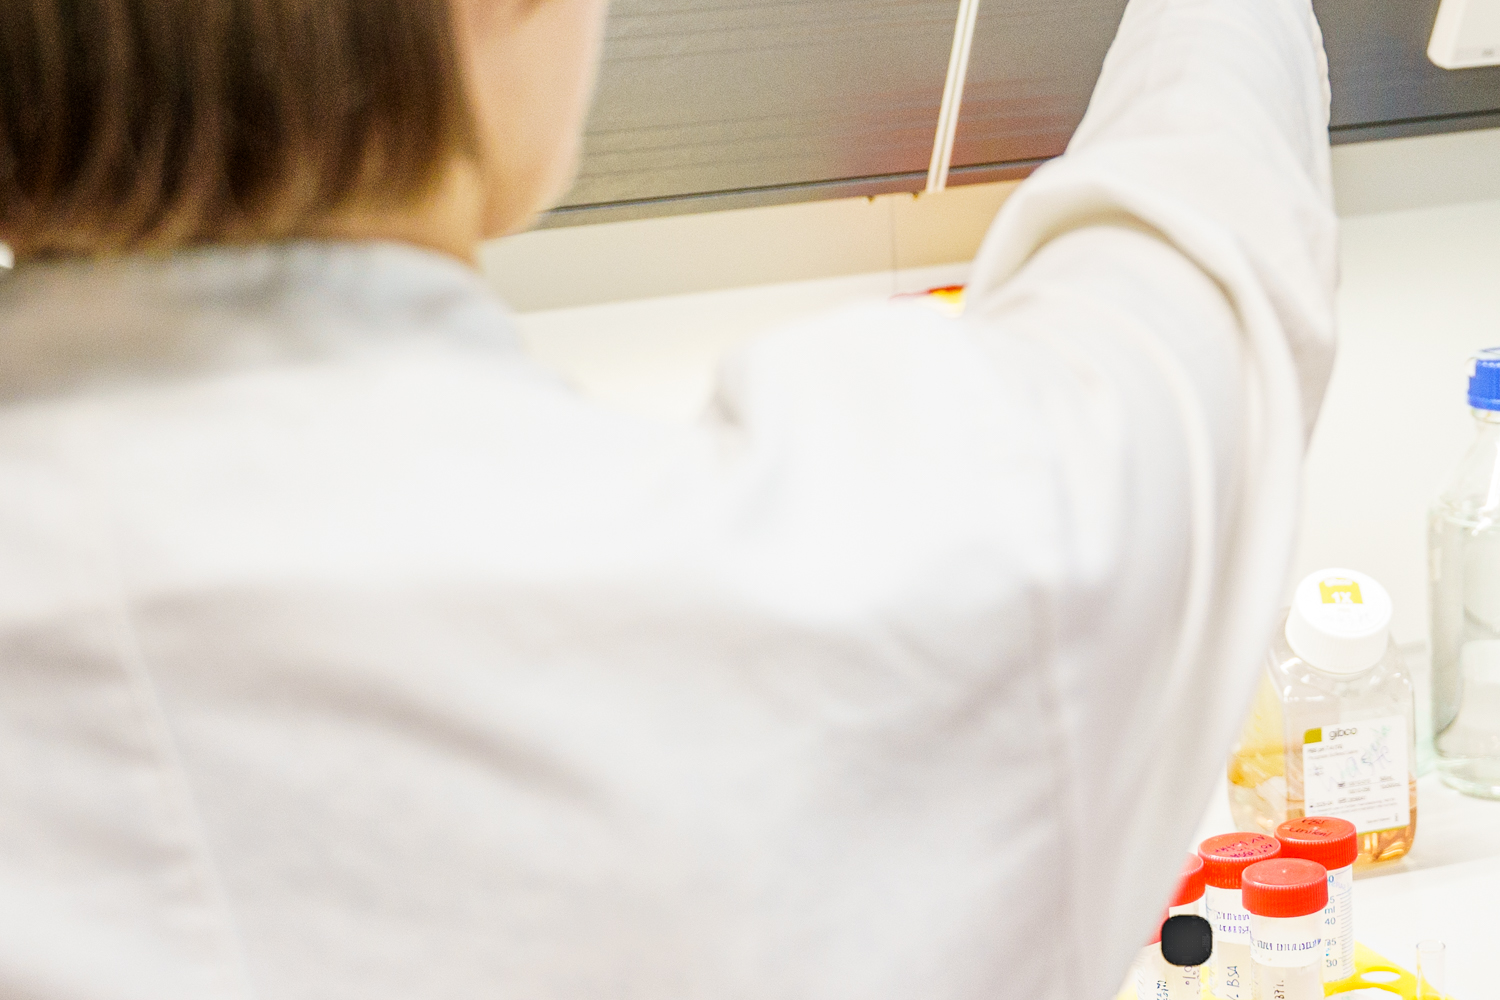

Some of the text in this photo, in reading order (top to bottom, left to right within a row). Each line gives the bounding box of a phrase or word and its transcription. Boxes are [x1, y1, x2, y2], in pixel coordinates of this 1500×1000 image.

[1331, 591, 1354, 604] 1X
[1328, 726, 1358, 740] gibco
[1324, 906, 1336, 914] ml
[1324, 917, 1336, 925] 40
[1326, 959, 1338, 968] 30
[1226, 964, 1240, 988] BSA
